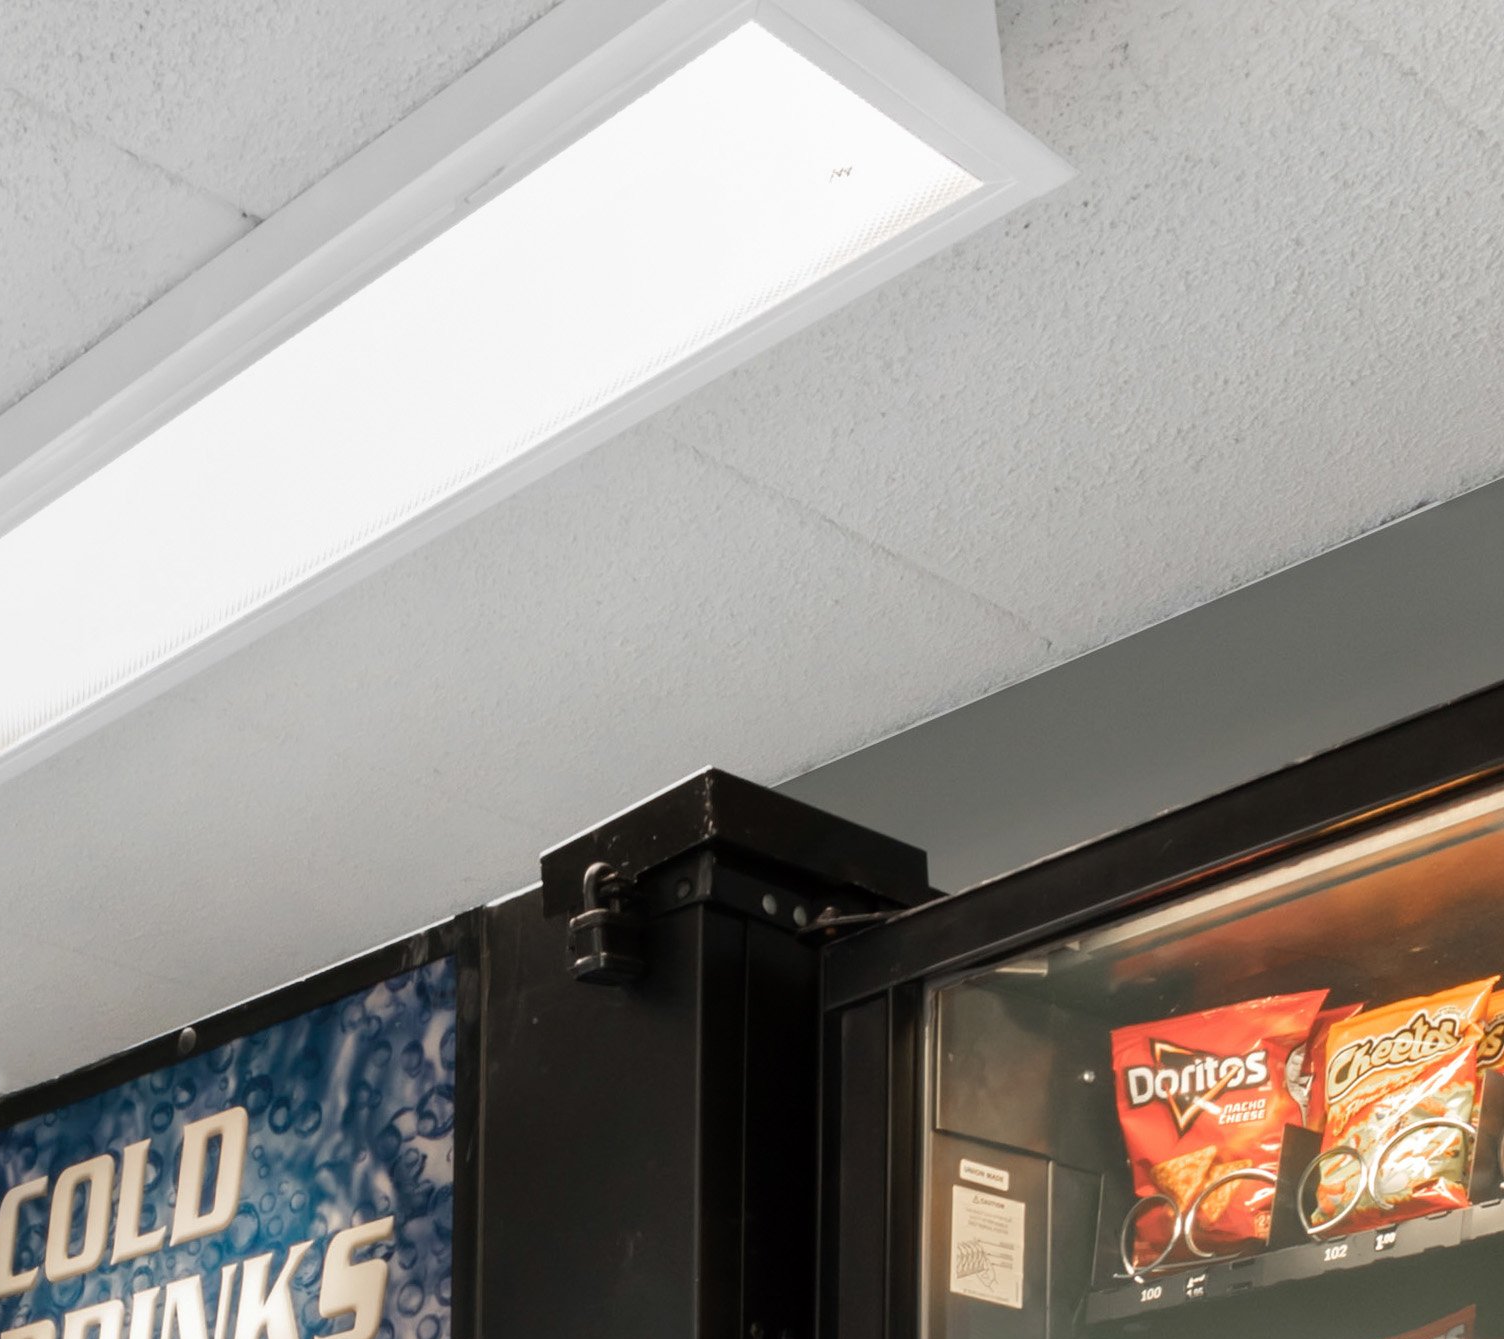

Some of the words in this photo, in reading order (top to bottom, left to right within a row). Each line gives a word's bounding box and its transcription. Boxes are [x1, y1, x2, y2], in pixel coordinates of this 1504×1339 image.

[1328, 1012, 1464, 1100] Cheetos
[1127, 1050, 1269, 1106] Doritos
[1222, 1098, 1267, 1116] NACHO
[1218, 1109, 1266, 1125] CHEESE
[1324, 1244, 1348, 1261] 102
[1141, 1286, 1162, 1302] 100
